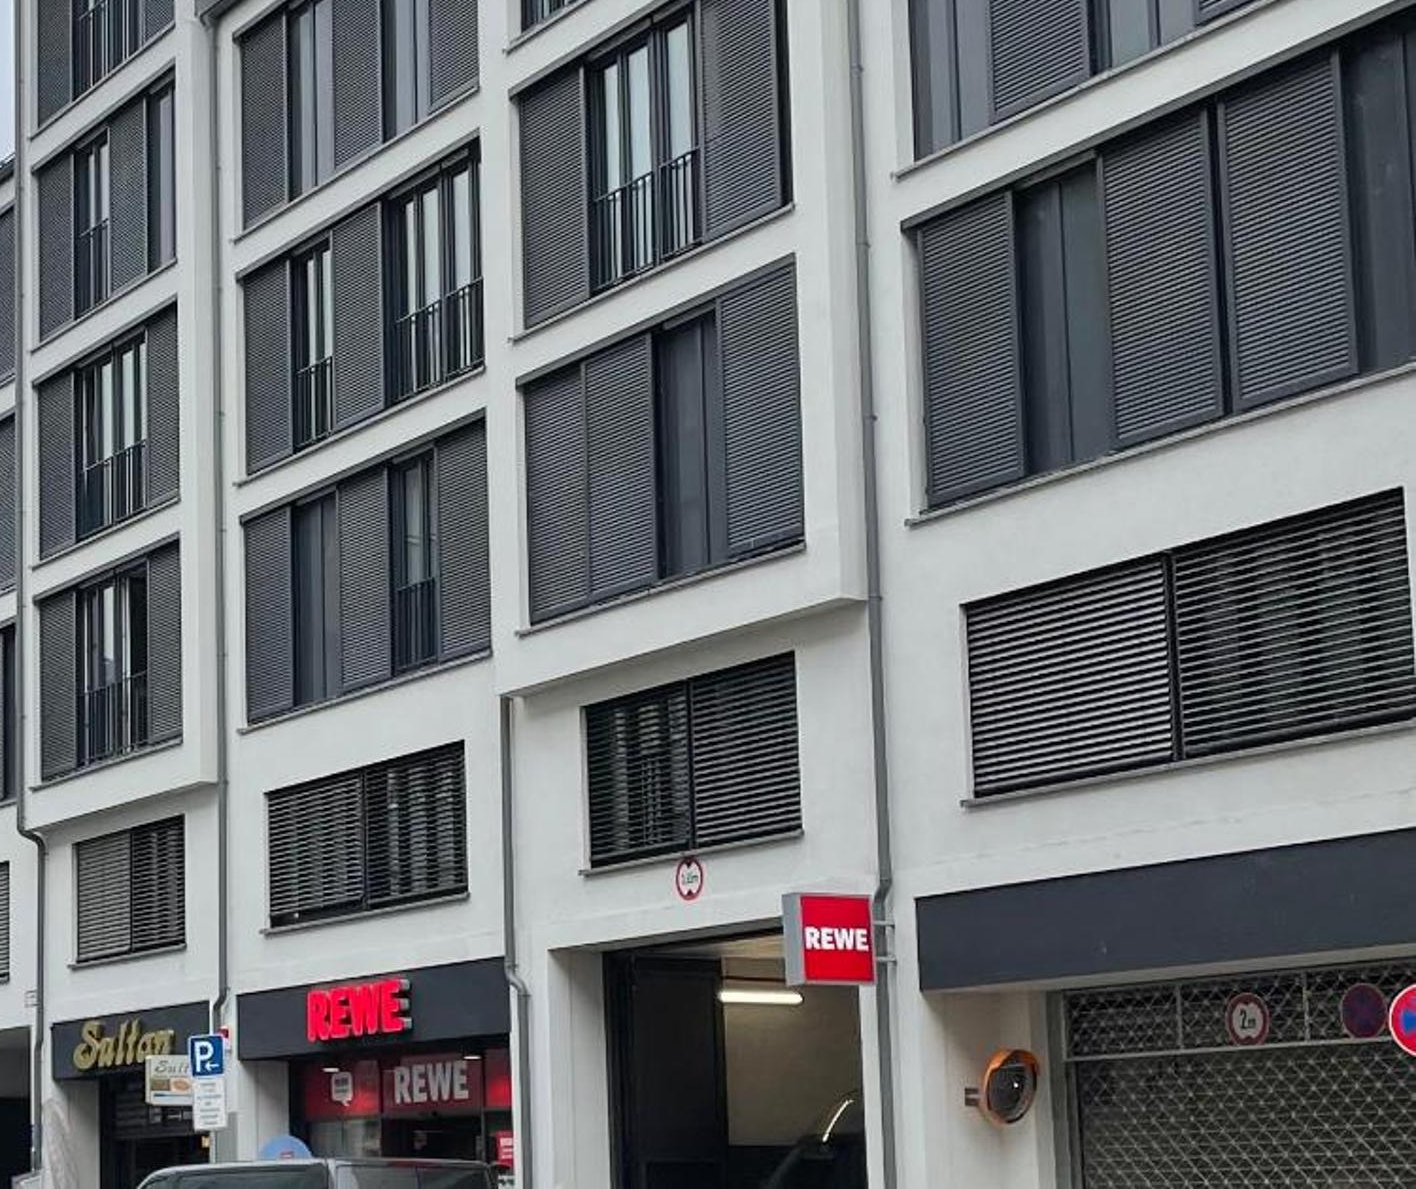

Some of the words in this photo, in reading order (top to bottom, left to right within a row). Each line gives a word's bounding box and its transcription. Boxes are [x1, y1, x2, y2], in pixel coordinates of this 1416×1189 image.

[804, 925, 869, 952] REWE
[307, 977, 409, 1042] REWE
[73, 1017, 175, 1070] Sultan
[194, 1041, 214, 1073] P
[394, 1060, 469, 1104] REWE
